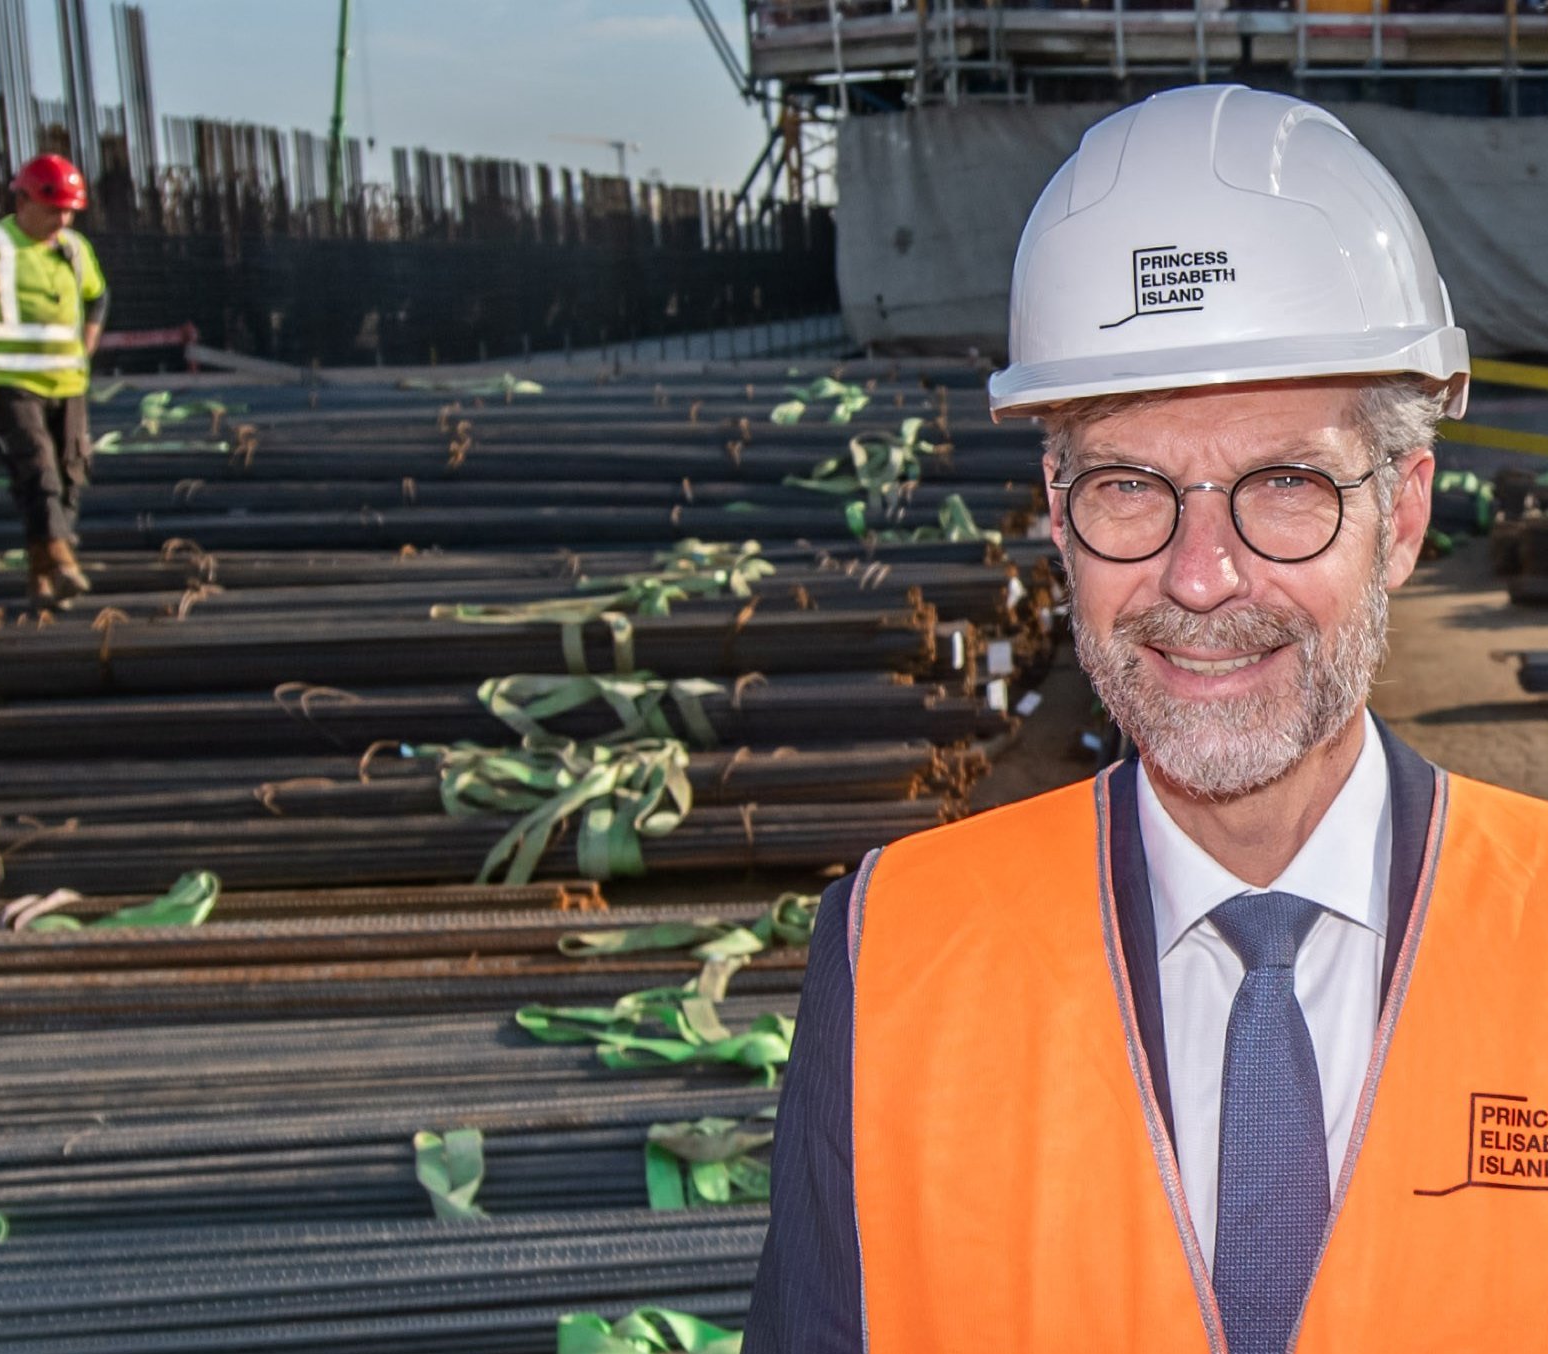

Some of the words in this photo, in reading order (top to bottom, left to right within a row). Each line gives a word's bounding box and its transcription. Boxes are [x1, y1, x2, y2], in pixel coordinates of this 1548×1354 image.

[1140, 251, 1228, 271] PRINCESS
[1141, 268, 1236, 289] ELISABETH
[1142, 287, 1204, 306] ISLAND
